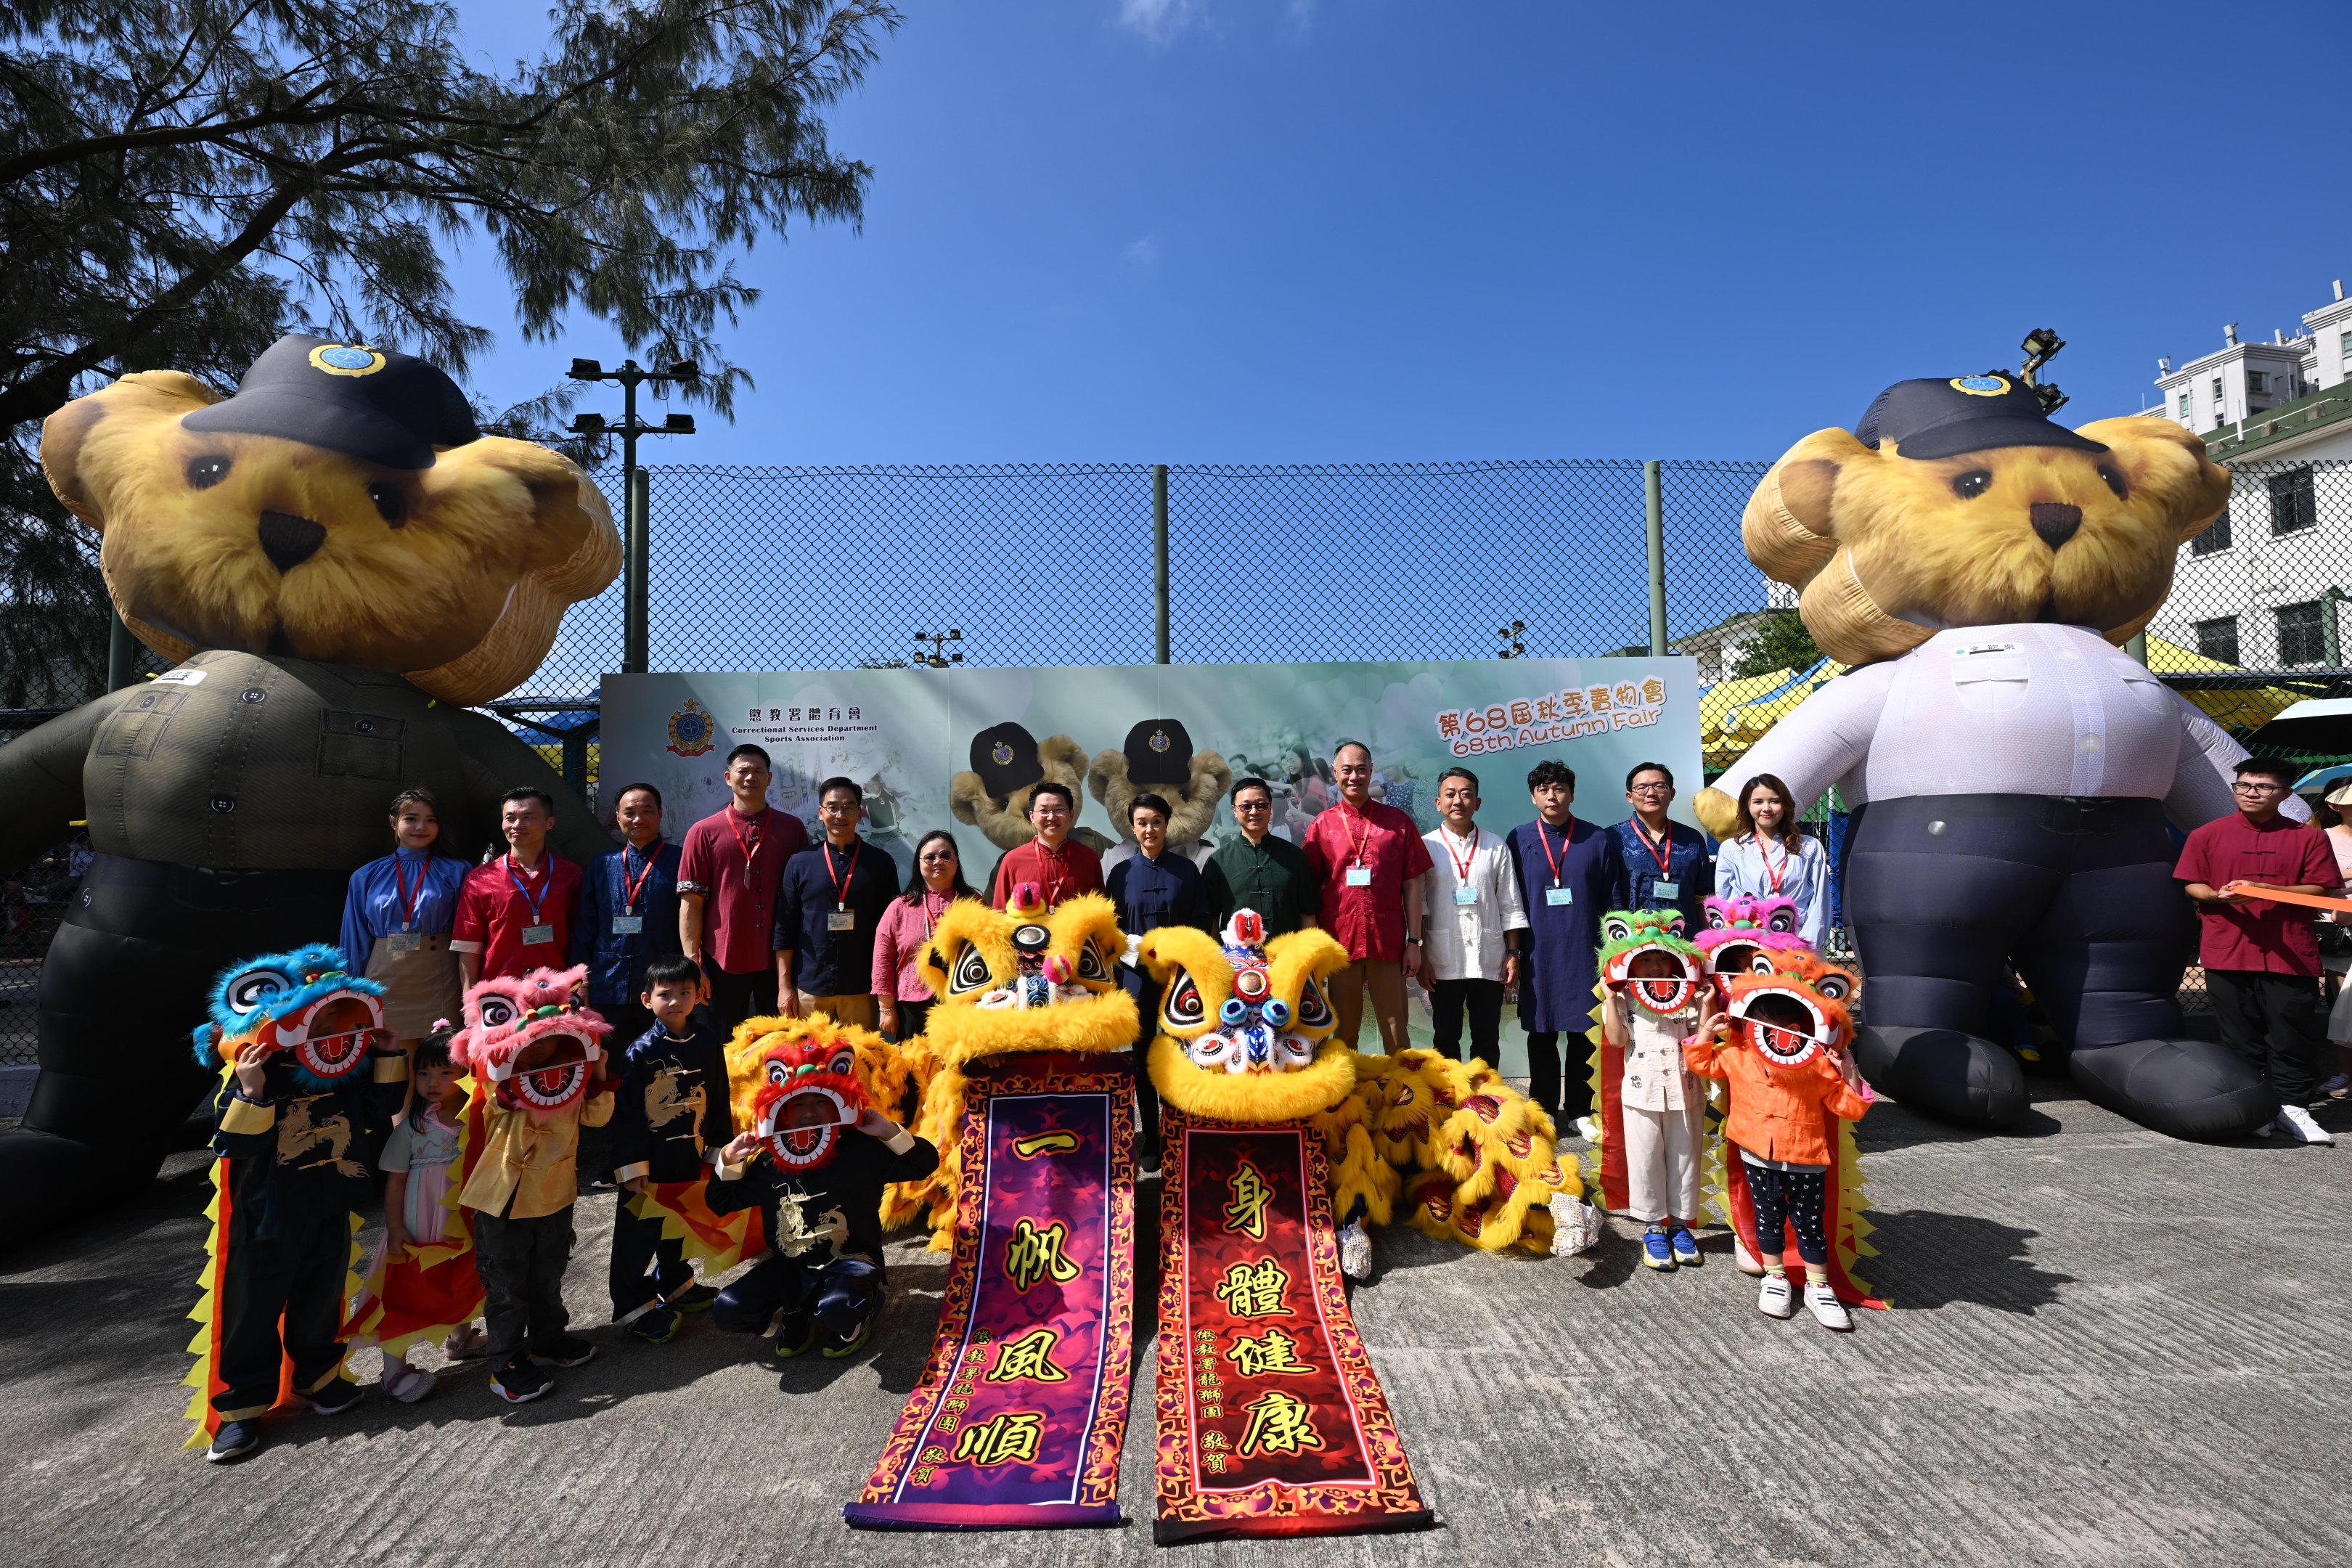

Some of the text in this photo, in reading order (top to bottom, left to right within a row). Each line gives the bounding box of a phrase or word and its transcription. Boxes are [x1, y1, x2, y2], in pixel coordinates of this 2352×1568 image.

[749, 707, 860, 722] 懲教署體育會
[1440, 679, 1663, 738] 第68屆秋季賣物會
[1453, 709, 1659, 755] 68th Autumn Fair
[959, 1133, 1081, 1465] 一帆風順
[1219, 1165, 1320, 1456] 身體健康
[913, 1448, 945, 1483] 敬賀
[1202, 1432, 1230, 1472] 敬賀
